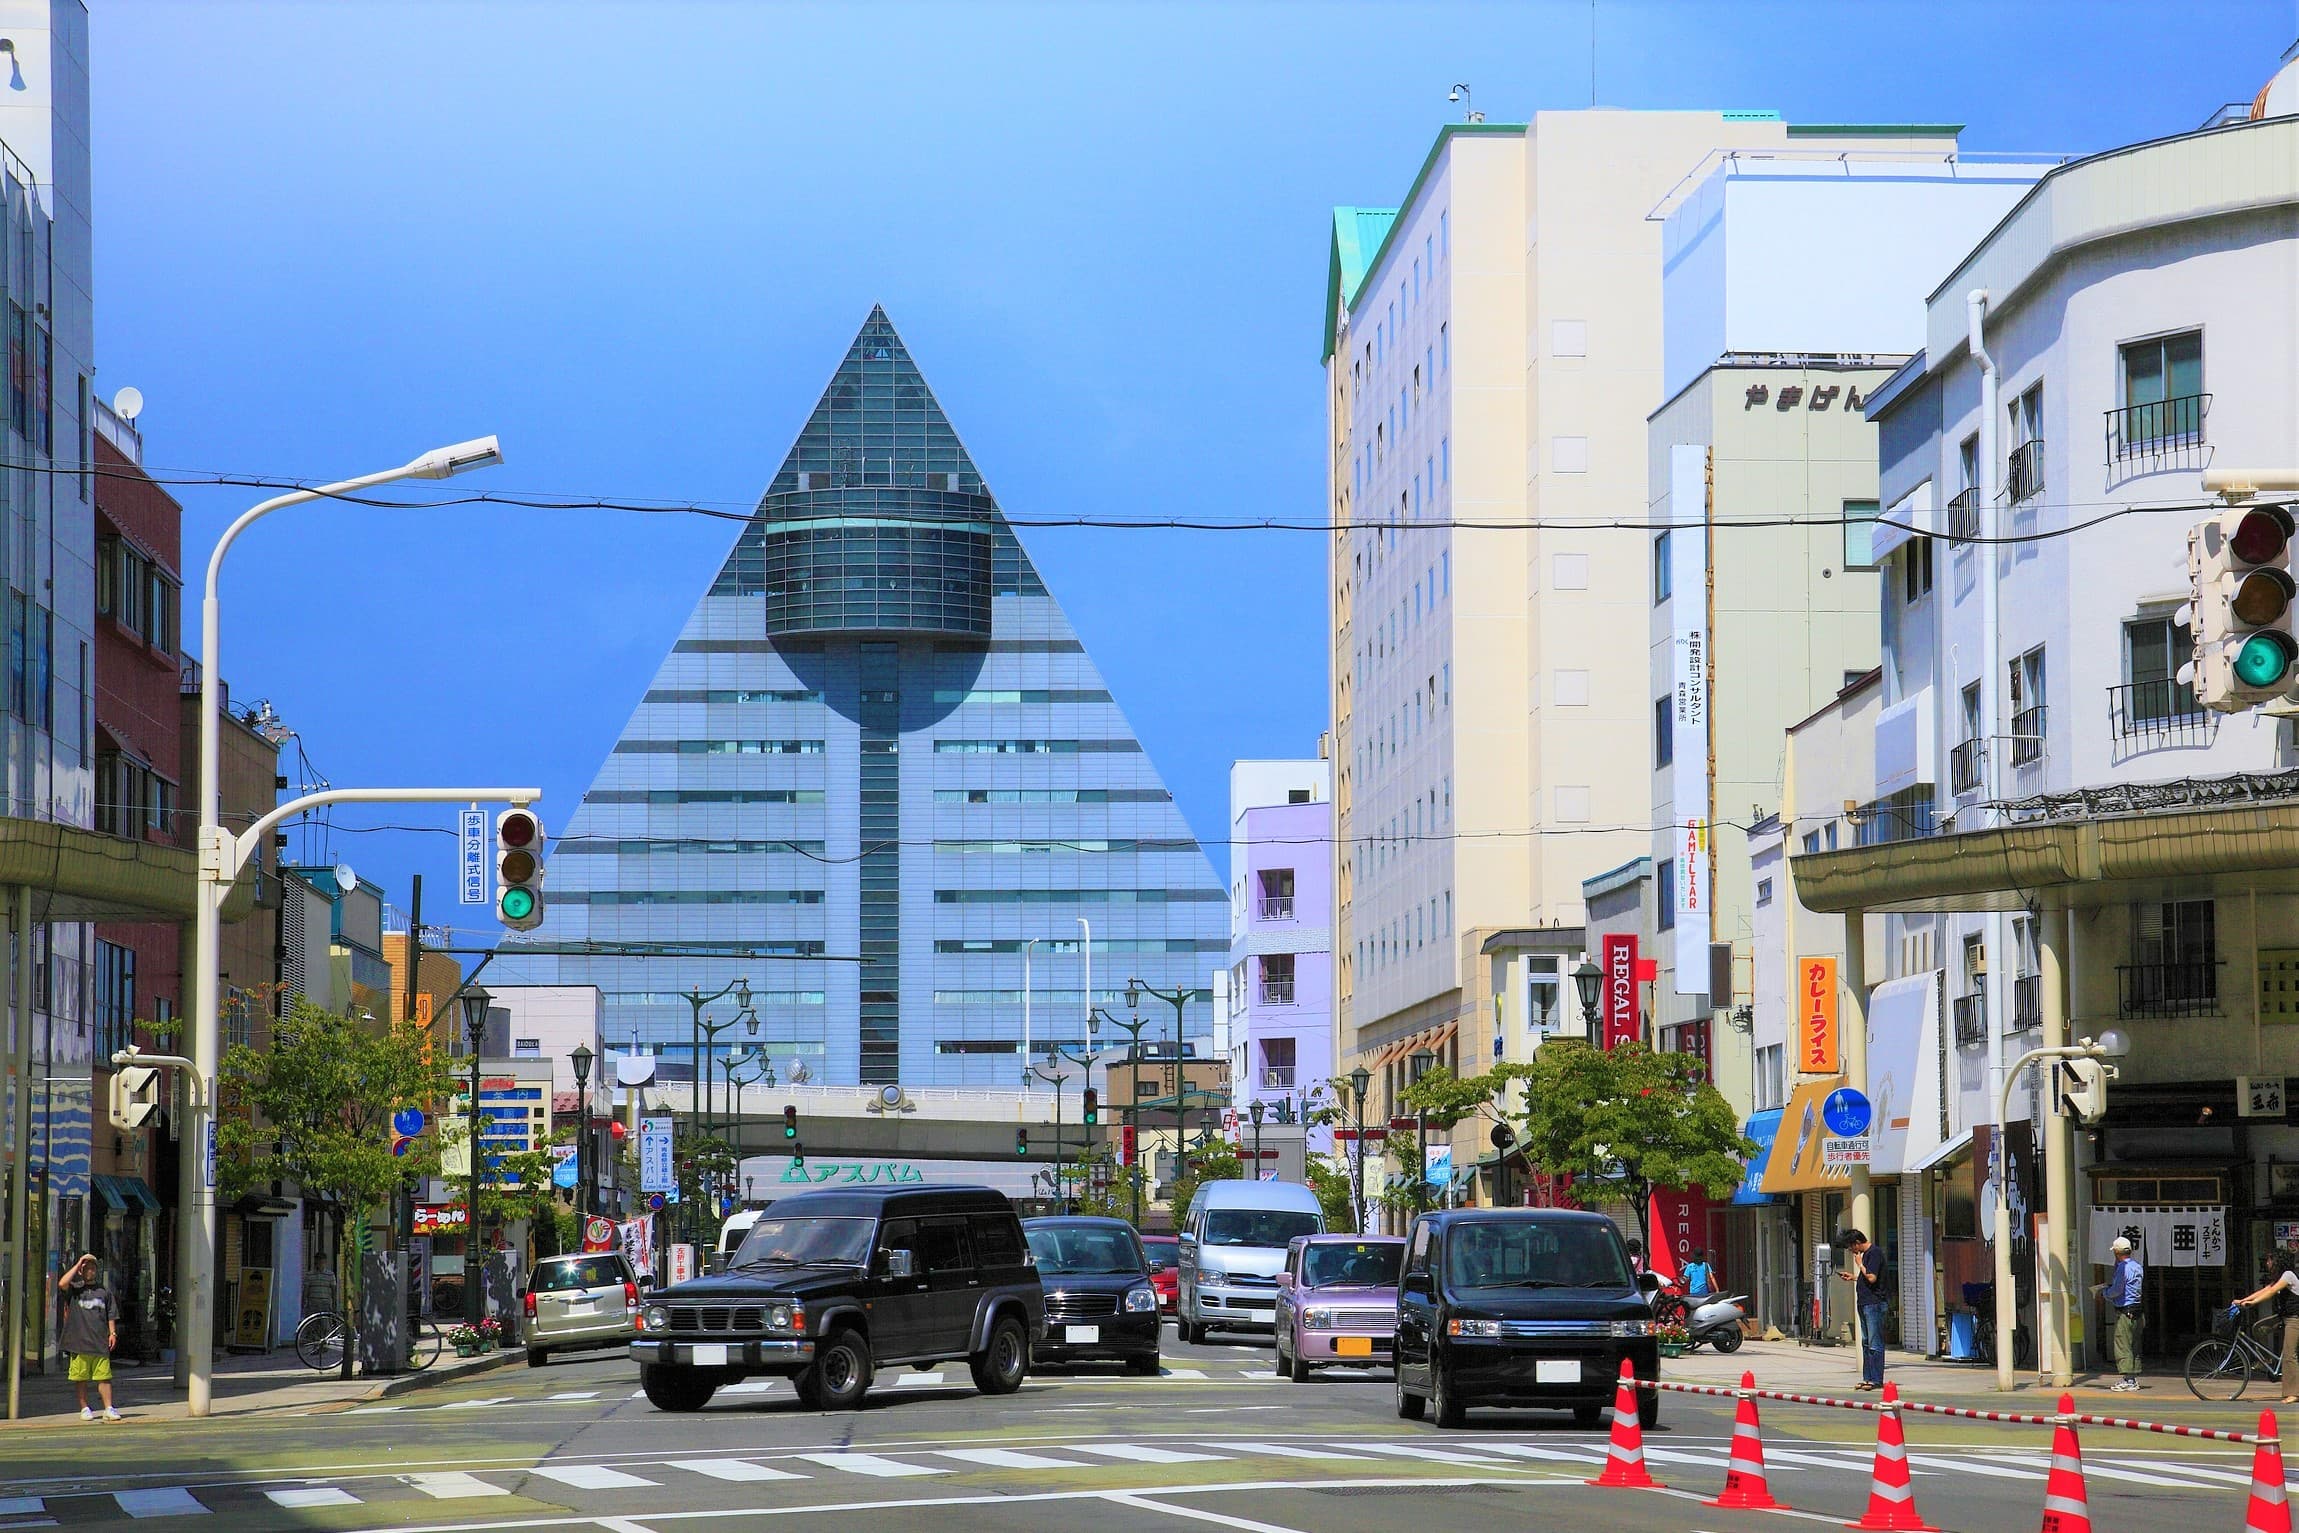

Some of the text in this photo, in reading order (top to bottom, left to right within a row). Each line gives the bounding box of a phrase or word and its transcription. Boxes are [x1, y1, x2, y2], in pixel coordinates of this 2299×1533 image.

[1745, 384, 1868, 412] やまげん
[467, 815, 480, 900] 歩車分離式信号
[1613, 944, 1631, 1027] REGAL
[1809, 963, 1827, 1065] カレーライス
[1826, 1140, 1869, 1151] 自転車通行可
[1827, 1151, 1870, 1161] 歩行者優先
[645, 1147, 654, 1184] アスパム
[812, 1163, 924, 1183] アスパム
[414, 1208, 466, 1224] らーめん
[1678, 1203, 1690, 1272] REGA
[2202, 1226, 2211, 1260] ステーキ
[2211, 1217, 2221, 1252] とんかつ
[676, 1247, 686, 1282] 左折工事中
